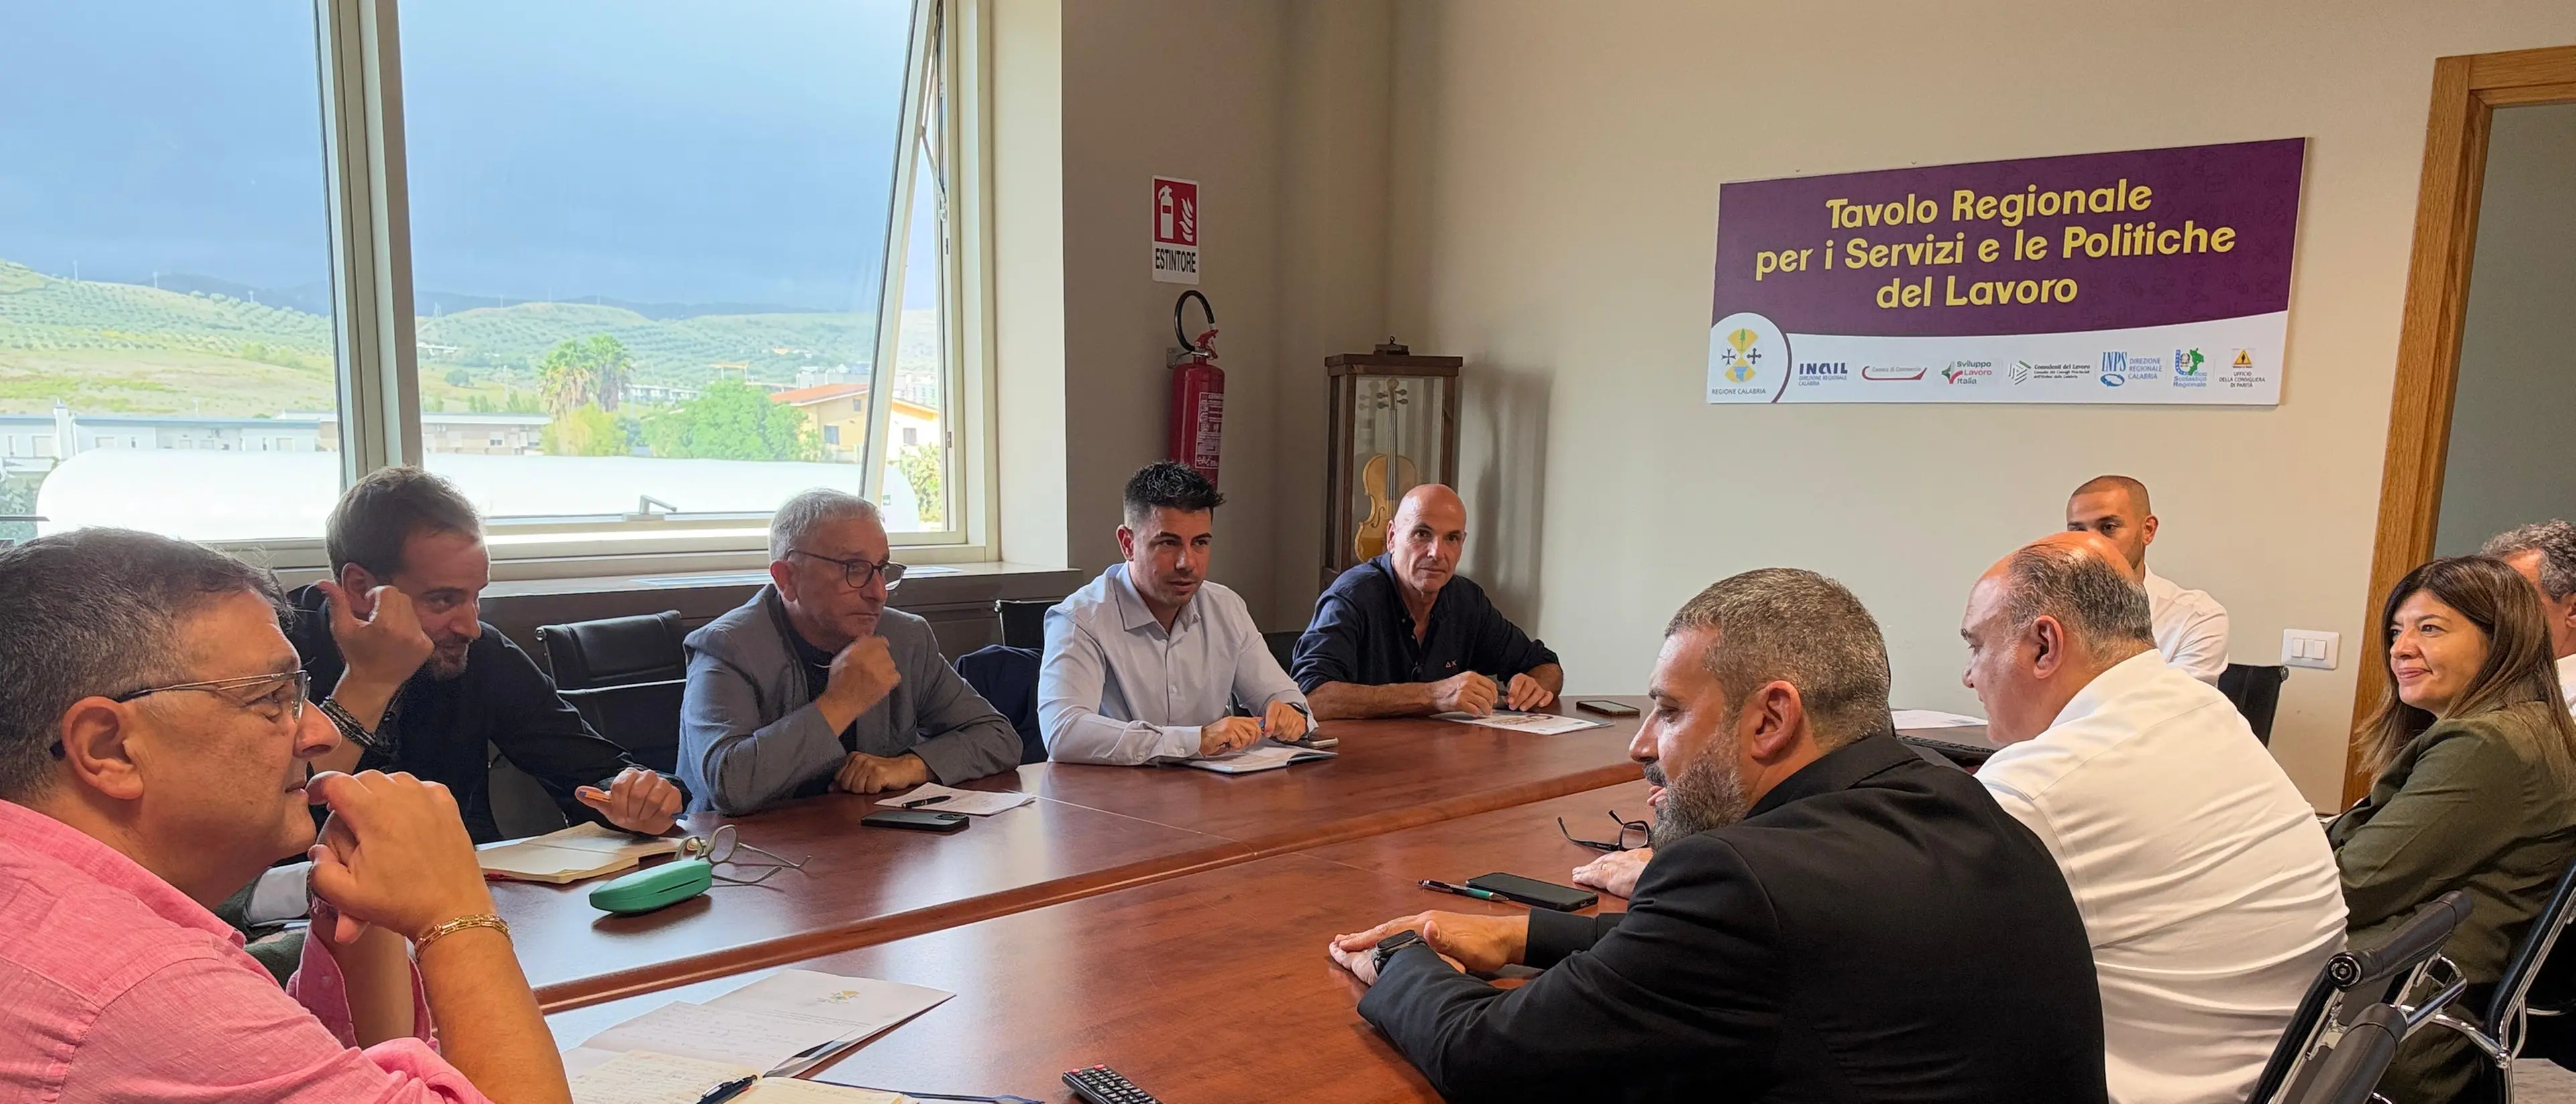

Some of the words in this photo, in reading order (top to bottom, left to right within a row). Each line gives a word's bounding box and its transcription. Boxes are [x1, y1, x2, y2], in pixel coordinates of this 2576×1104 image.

[1825, 193, 1938, 229] Tavolo
[1952, 179, 2152, 227] Regionale
[1155, 248, 1196, 273] ESTINTORE
[1756, 248, 1814, 281] per
[1825, 240, 1834, 270] i
[1845, 232, 1965, 269] Servizi
[1978, 238, 2000, 262] e
[2015, 230, 2048, 260] le
[2063, 220, 2237, 258] Politiche
[1876, 276, 1932, 309] del
[1945, 275, 2078, 306] Lavoro
[1799, 362, 1848, 374] INAIL
[1956, 360, 1992, 369] Sviluppo
[2102, 351, 2127, 372] INPS
